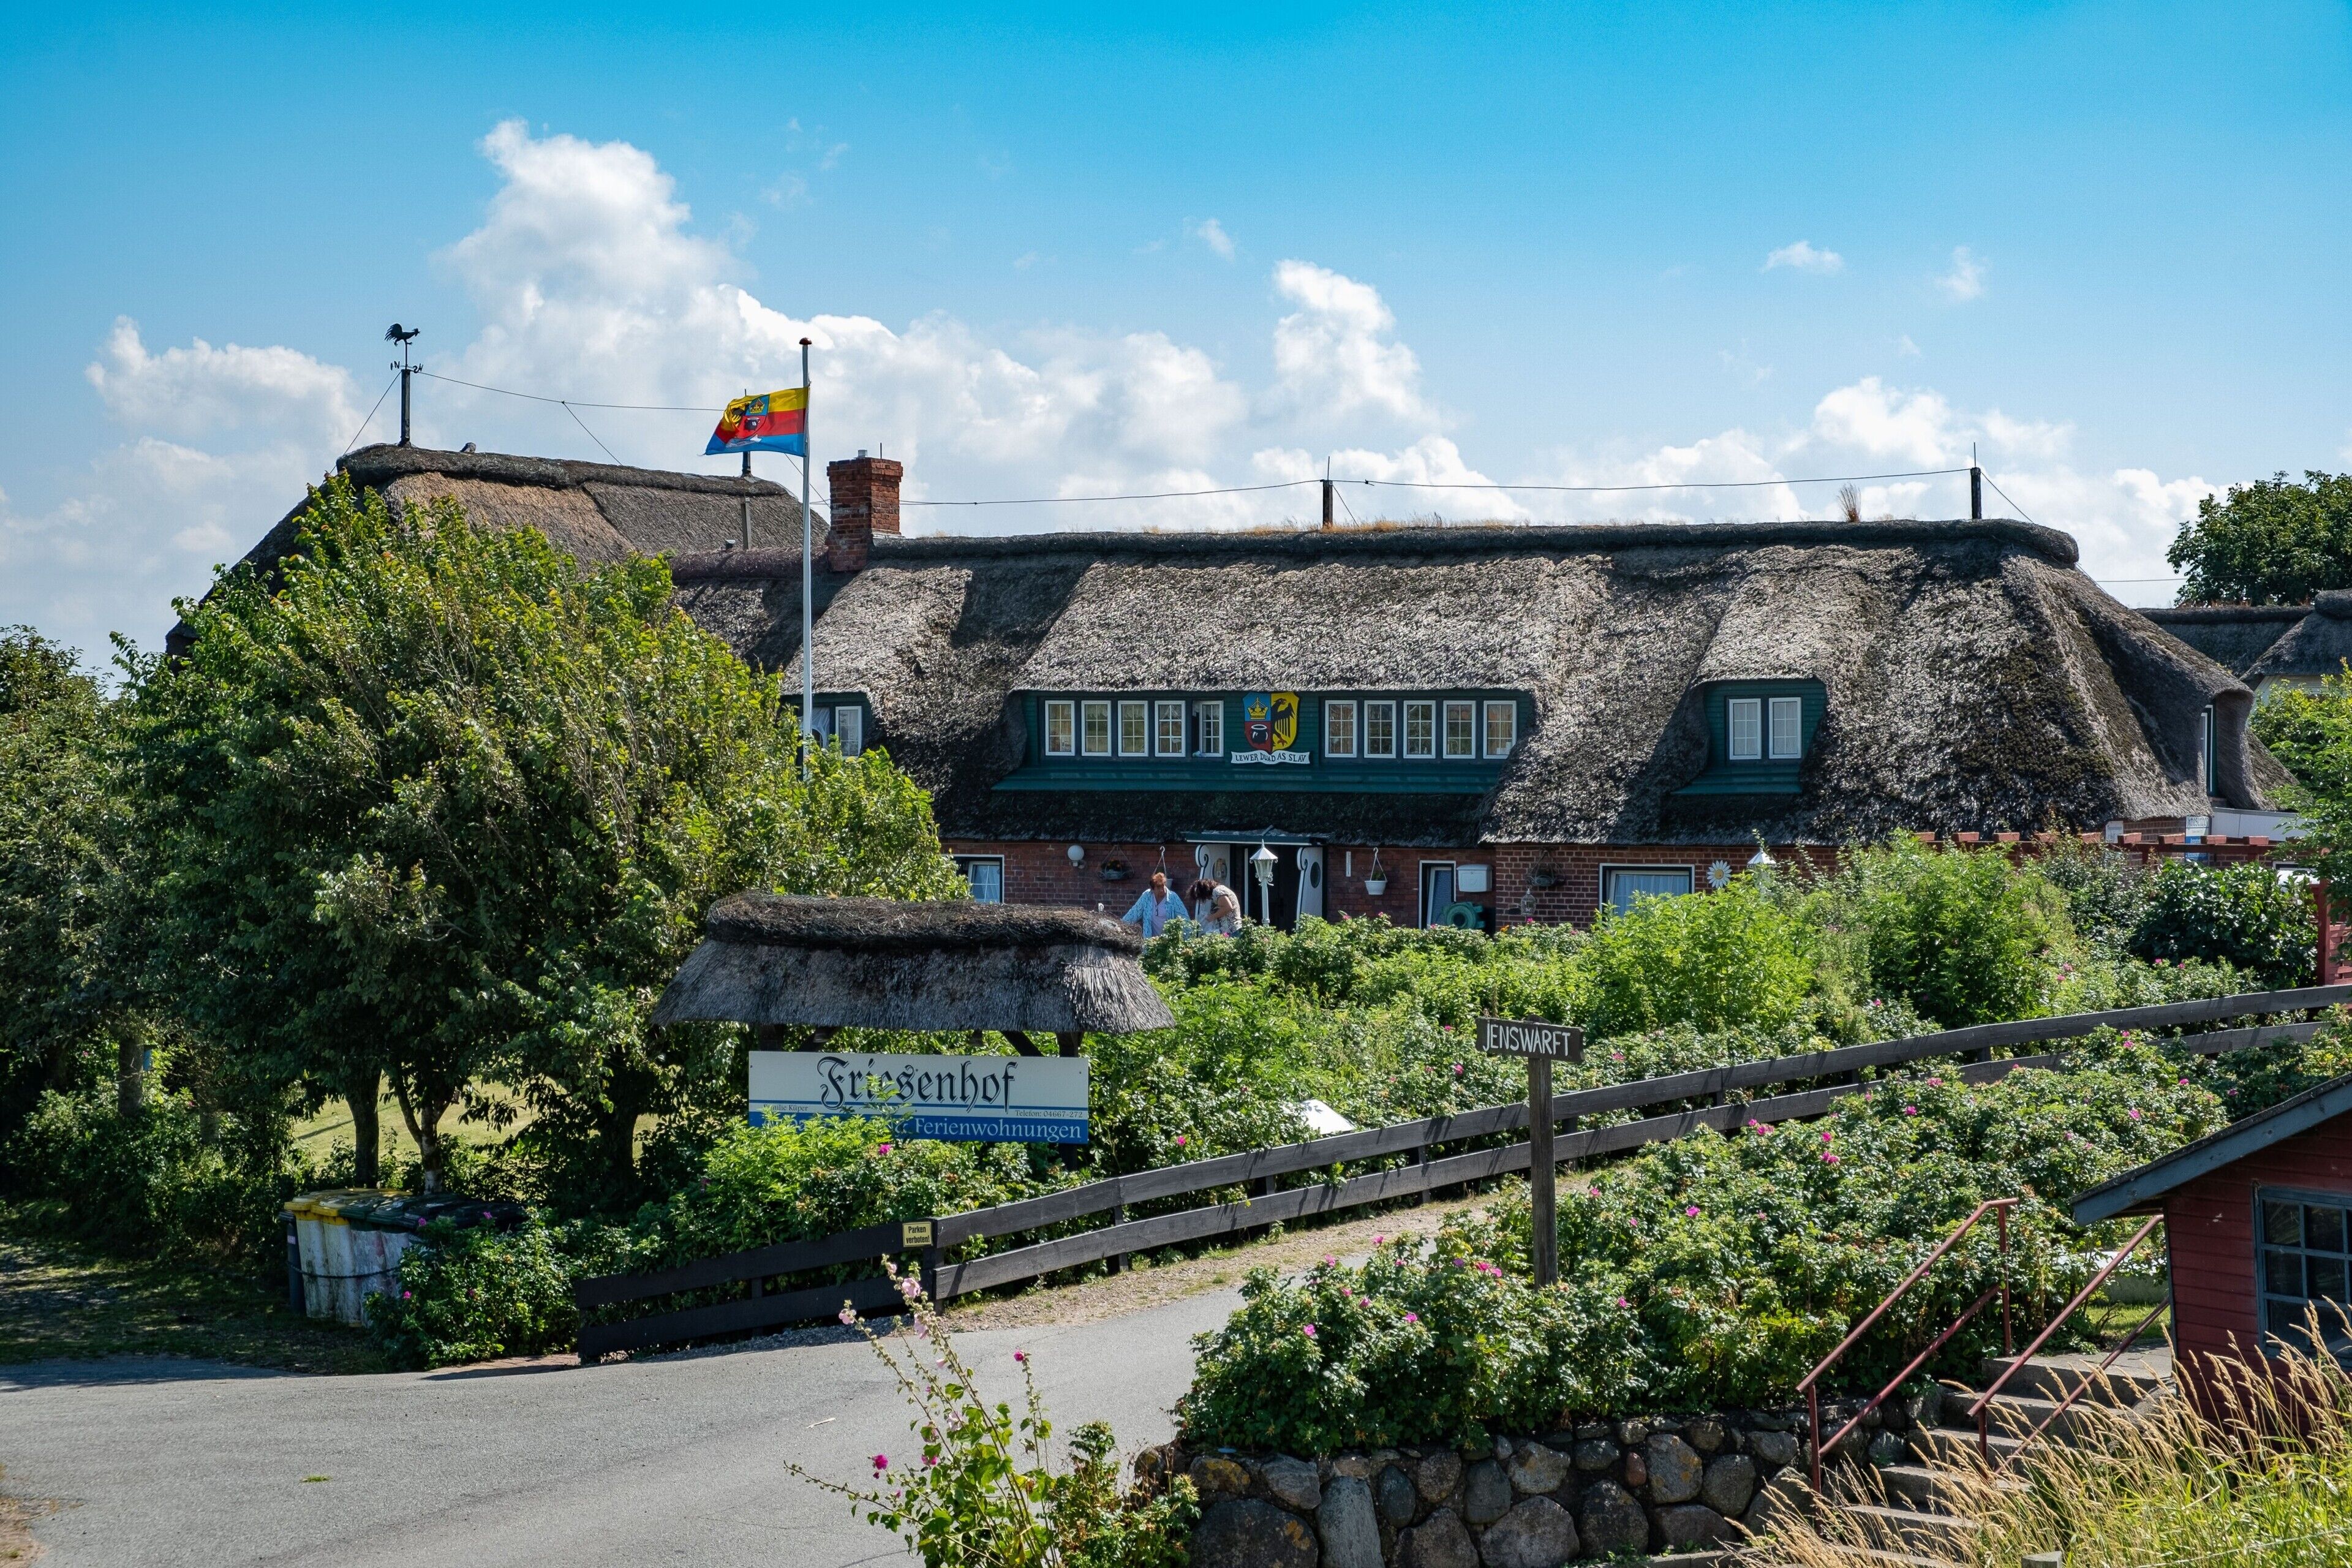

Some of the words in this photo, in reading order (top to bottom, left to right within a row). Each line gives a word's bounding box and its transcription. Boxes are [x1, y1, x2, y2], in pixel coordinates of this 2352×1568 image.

[1260, 753, 1275, 762] DUAD
[1289, 753, 1306, 762] SLAV
[1482, 1022, 1571, 1057] JENSWARFT
[817, 1056, 1018, 1114] Friesenhof
[915, 1117, 1082, 1143] Ferienwohnungen
[905, 1235, 930, 1244] verboten!
